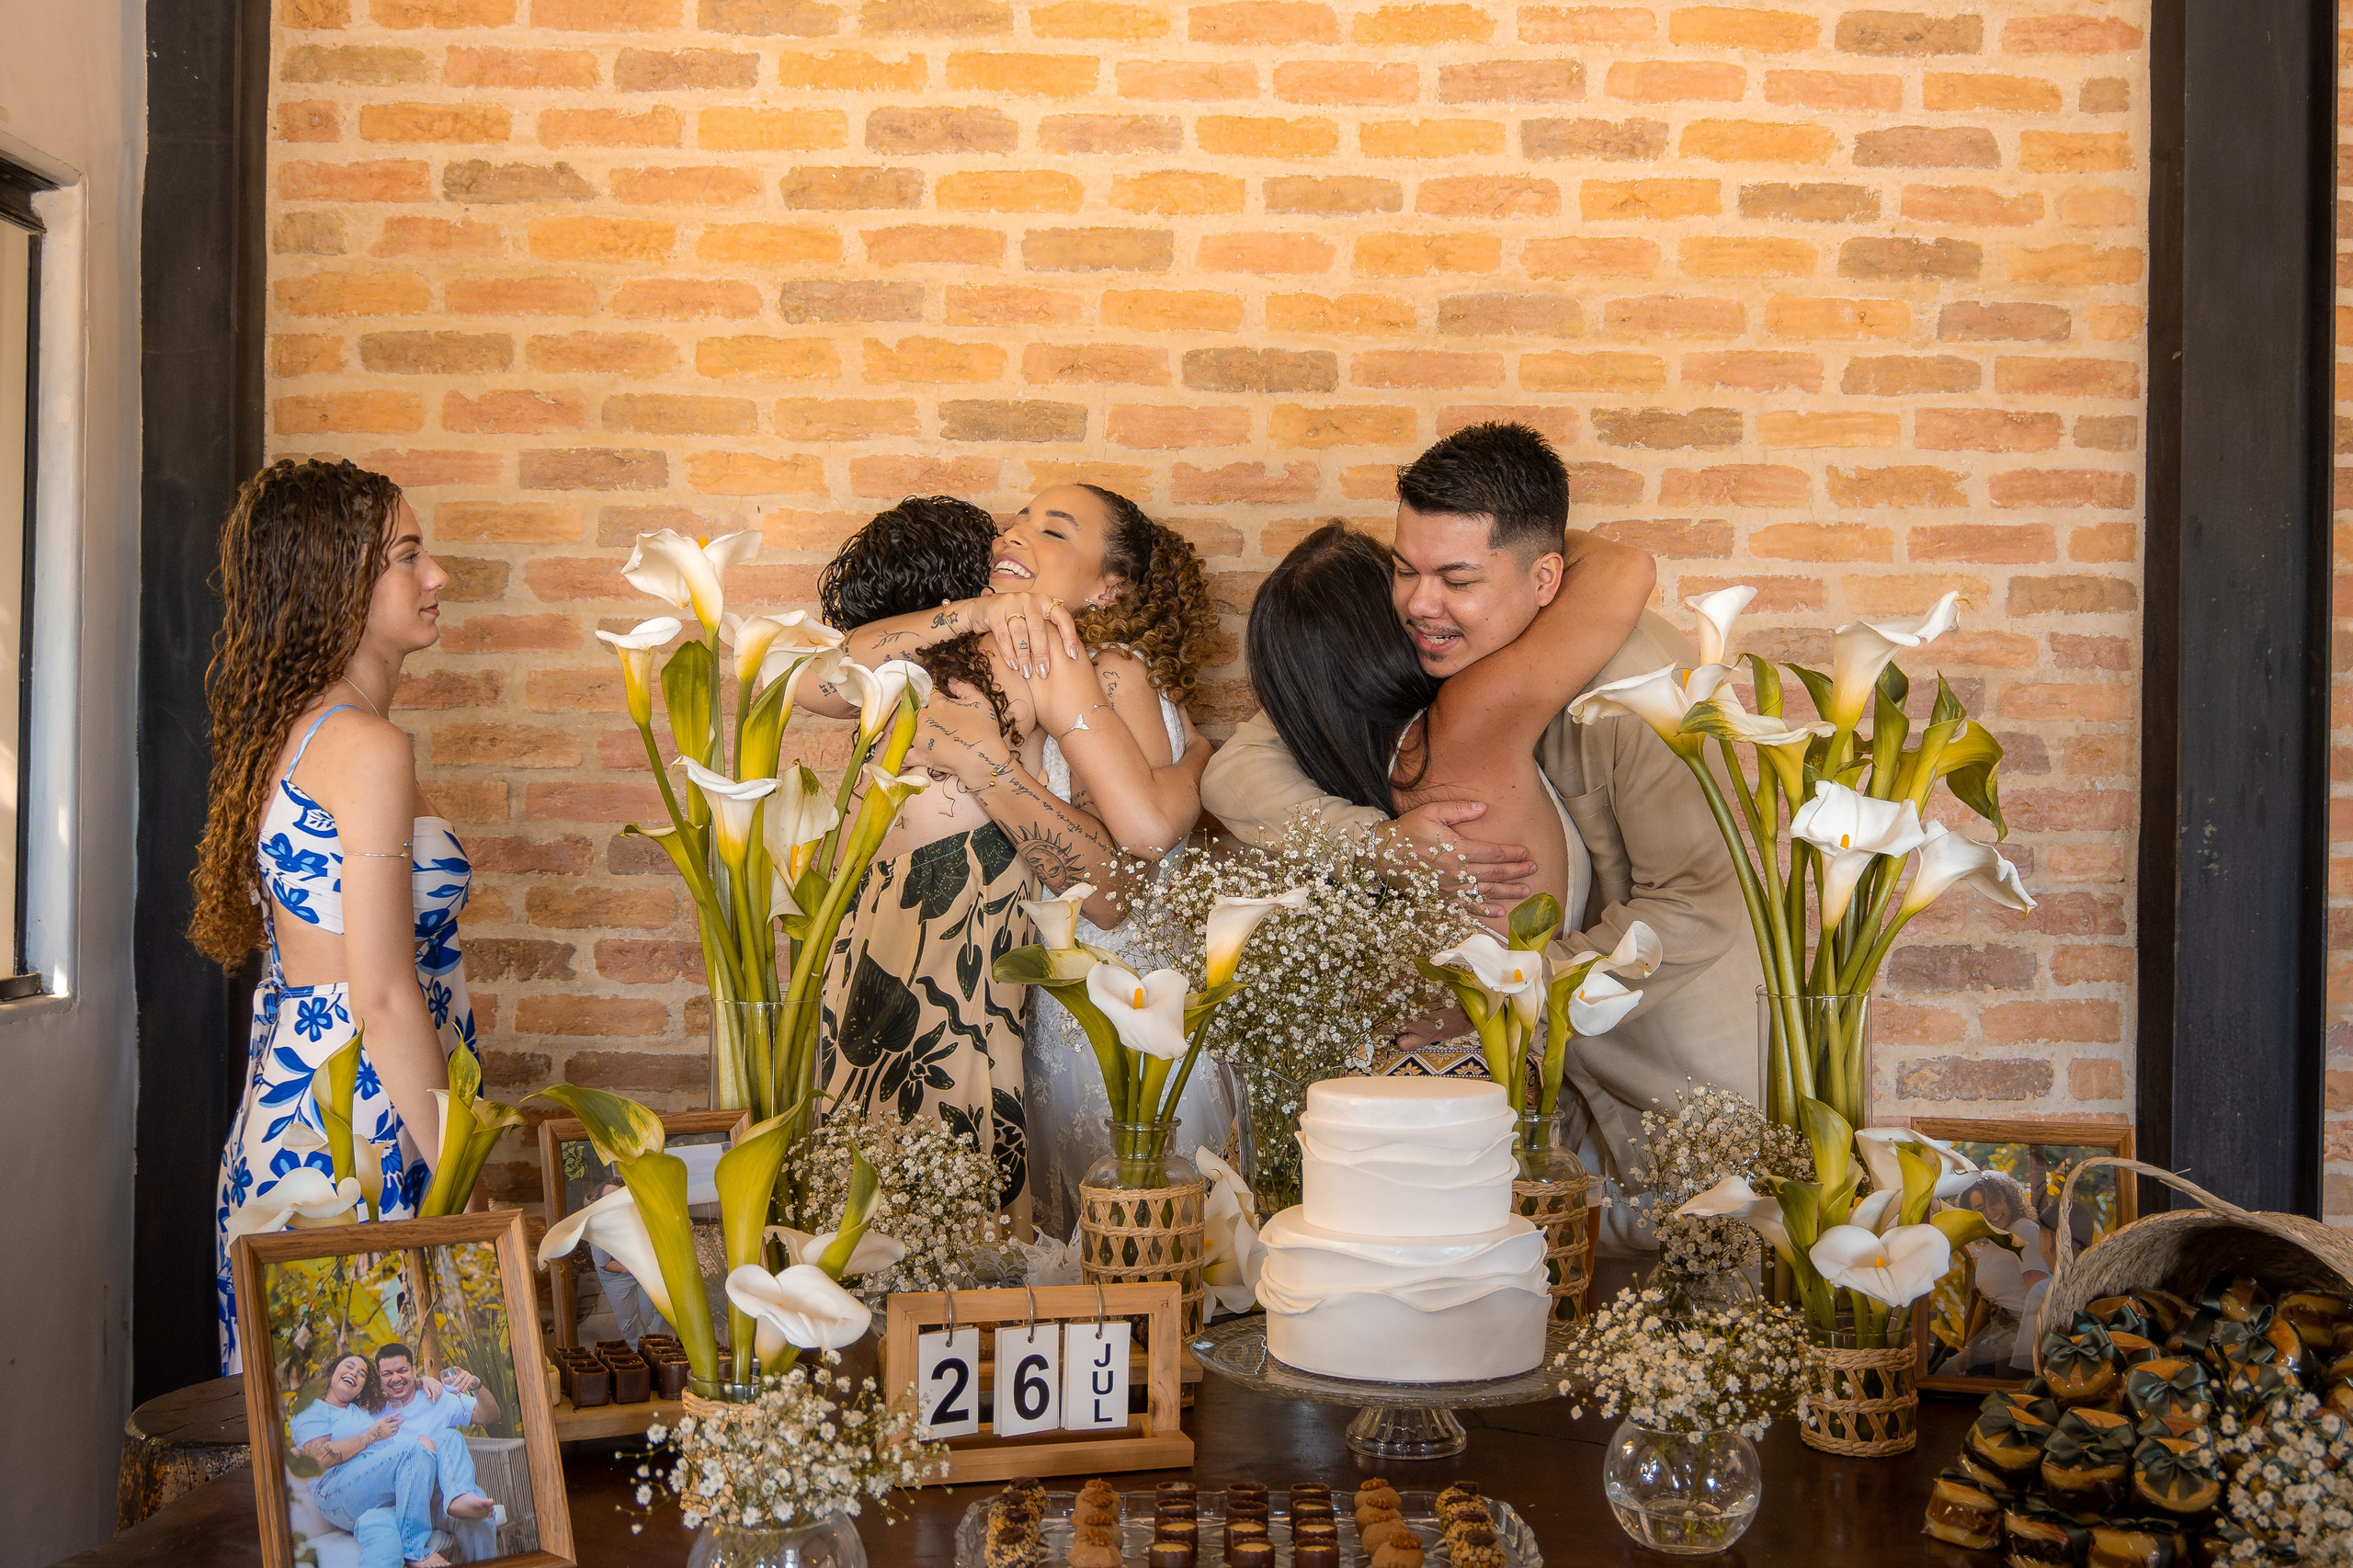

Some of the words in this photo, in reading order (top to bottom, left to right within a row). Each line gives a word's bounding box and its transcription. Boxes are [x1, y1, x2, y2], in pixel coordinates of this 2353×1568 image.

[952, 736, 983, 750] que
[1009, 778, 1041, 801] melhor
[1085, 831, 1098, 843] que
[1092, 1343, 1115, 1424] JUL
